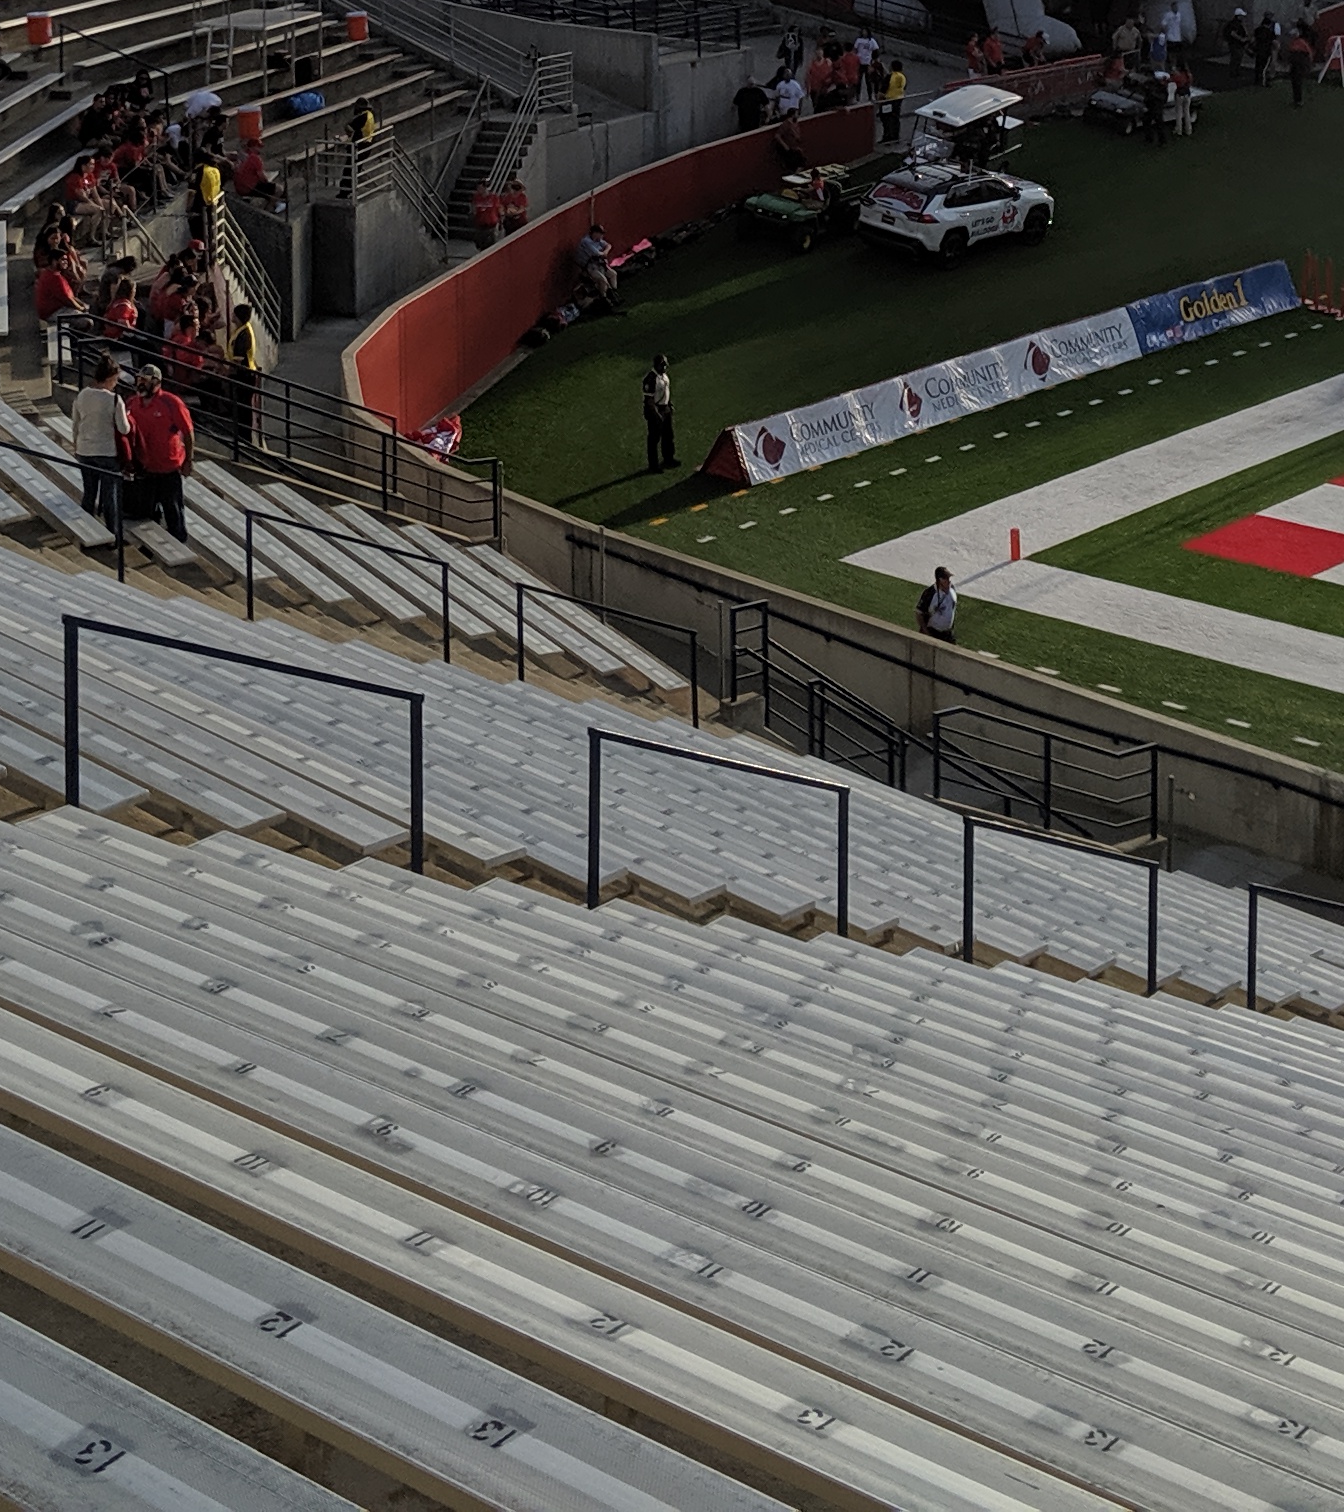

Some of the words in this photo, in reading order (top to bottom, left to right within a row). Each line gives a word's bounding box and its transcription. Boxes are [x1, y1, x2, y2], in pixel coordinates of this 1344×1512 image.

[70, 1219, 106, 1239] 11
[405, 1230, 436, 1247] 11
[1105, 1221, 1133, 1237] 10
[697, 1262, 724, 1279] 11
[907, 1267, 933, 1283] 11
[1096, 1281, 1119, 1296] 11
[1261, 1281, 1283, 1294] 11
[260, 1311, 303, 1339] 12
[591, 1313, 629, 1335] 12
[880, 1338, 916, 1362] 12
[1082, 1338, 1116, 1359] 12
[1269, 1348, 1297, 1366] 12
[797, 1407, 837, 1430] 13
[472, 1420, 518, 1448] 13
[1084, 1428, 1119, 1452] 13
[1277, 1419, 1310, 1440] 13
[74, 1439, 127, 1474] 13
